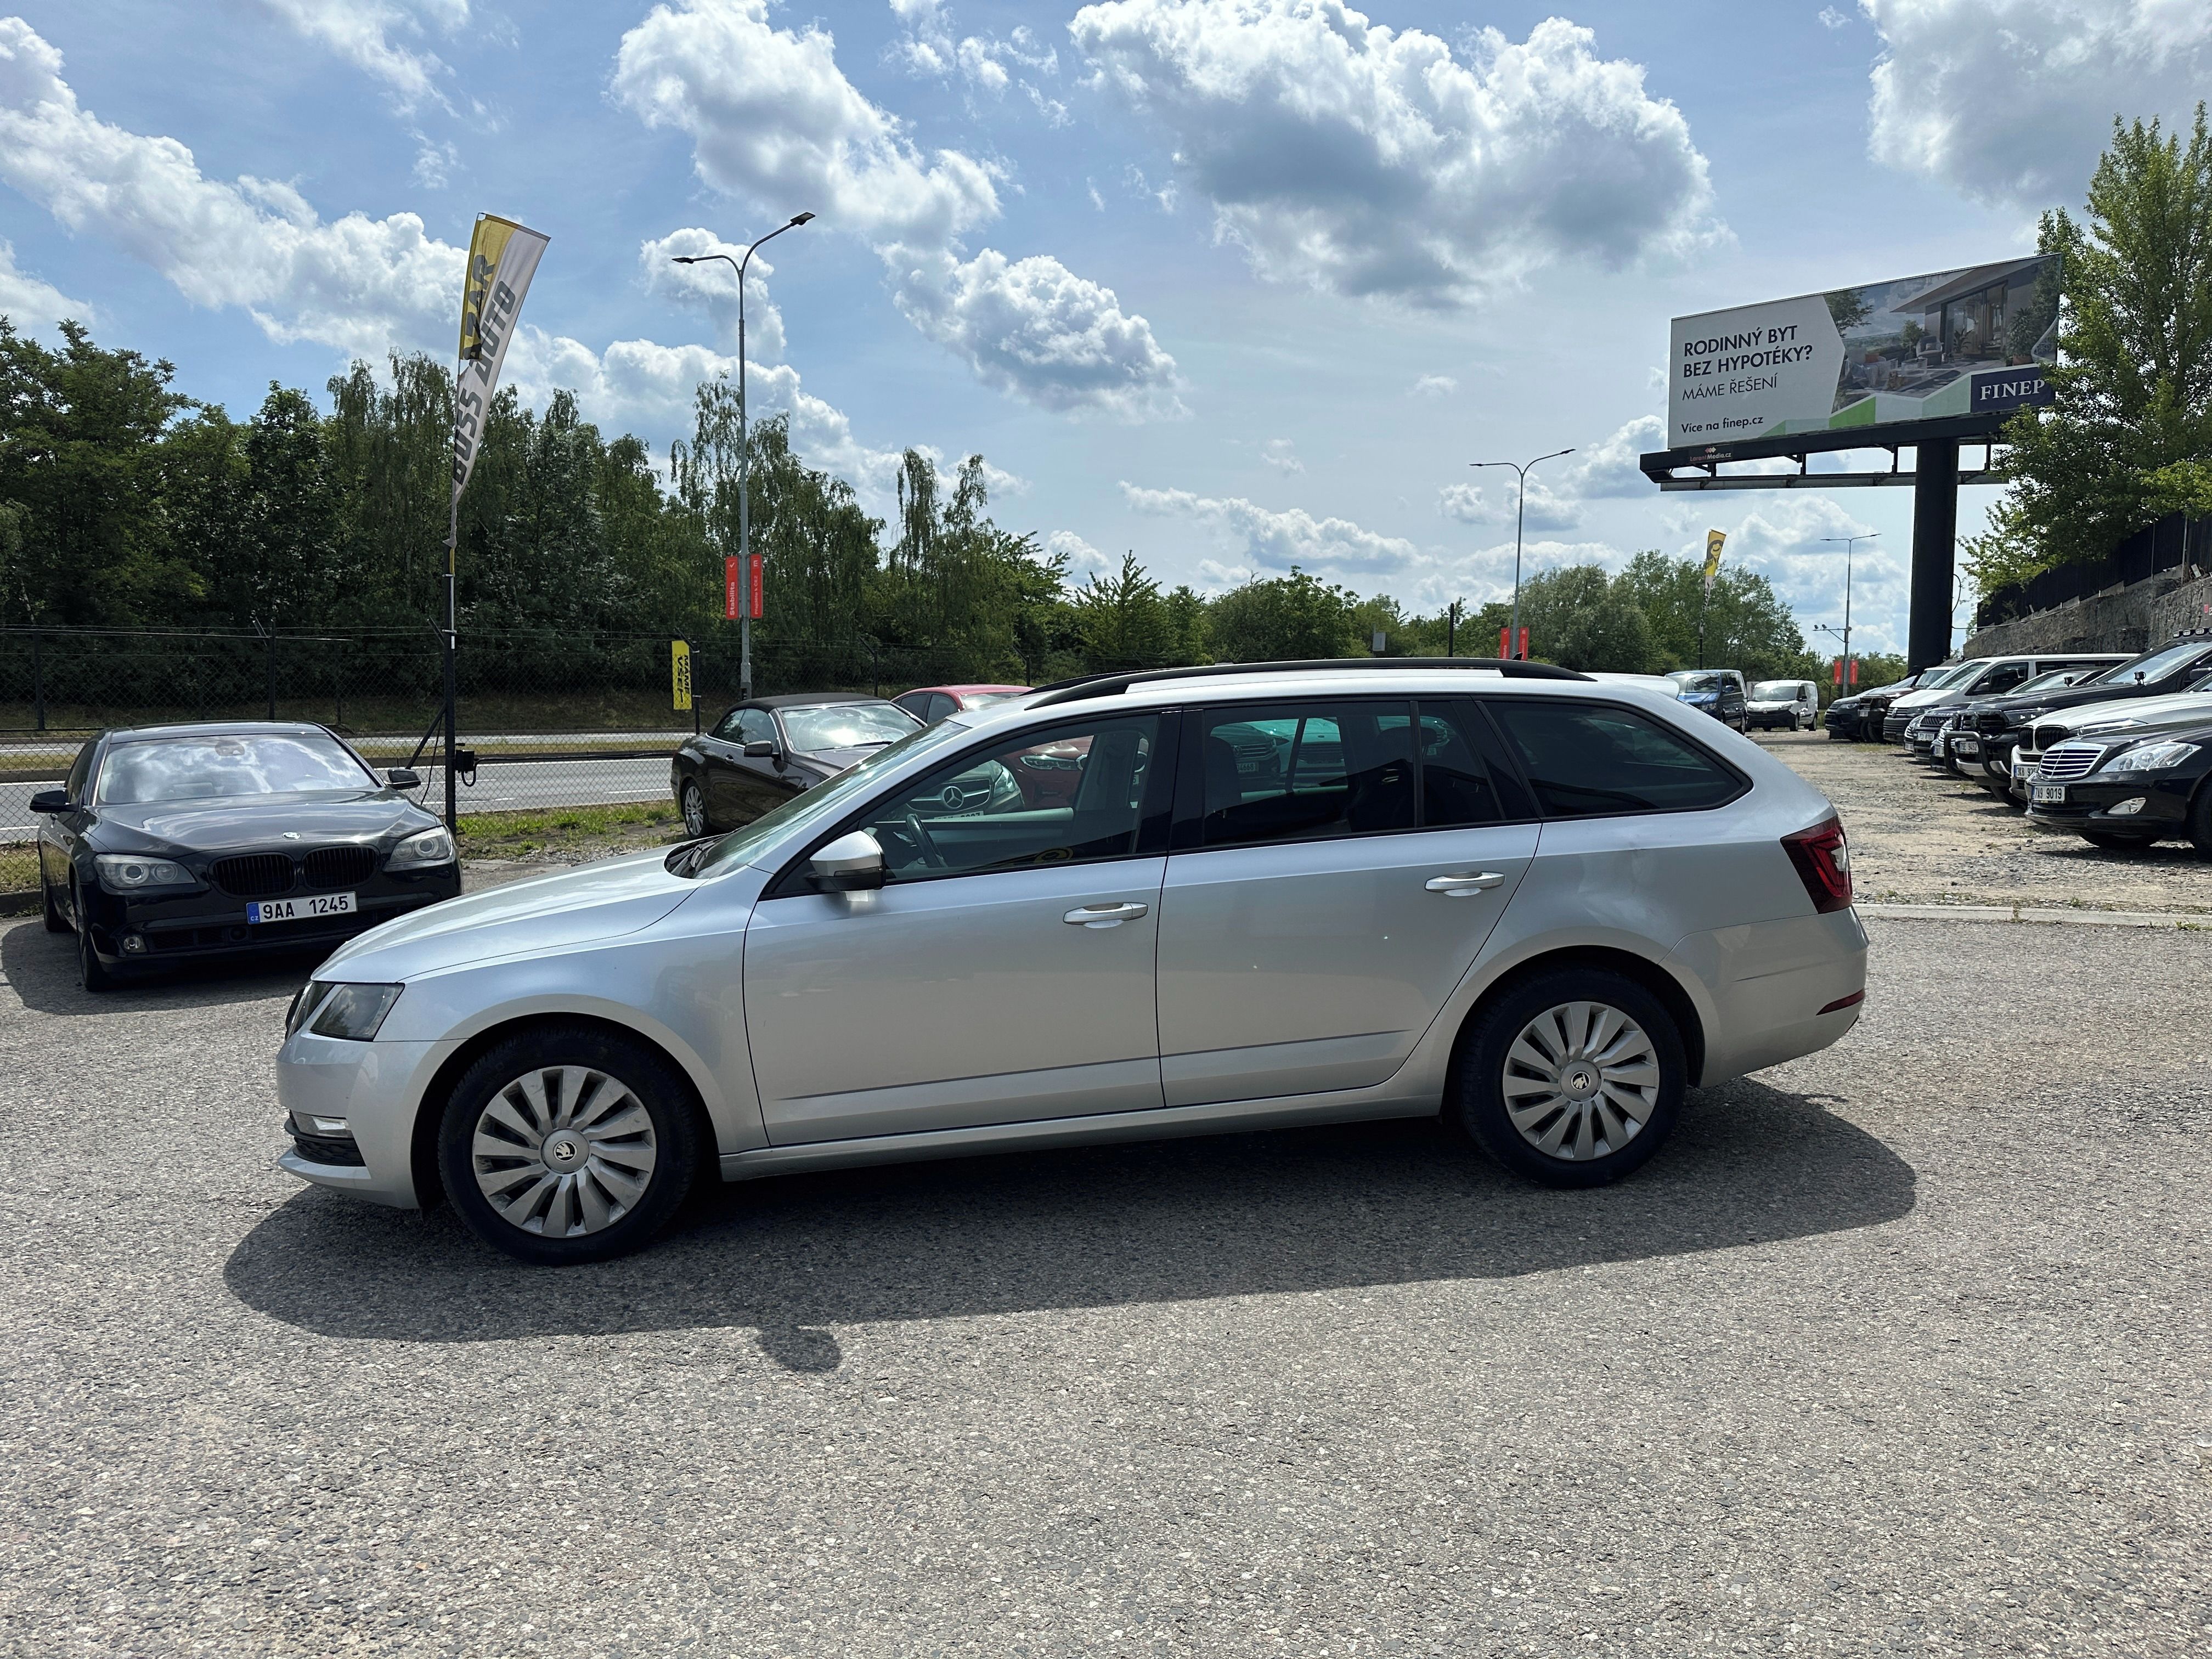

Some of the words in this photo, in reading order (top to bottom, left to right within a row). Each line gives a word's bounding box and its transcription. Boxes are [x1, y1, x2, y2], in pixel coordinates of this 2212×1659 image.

[1684, 327, 1763, 357] RODINNÝ
[1768, 325, 1797, 344] BYT
[1683, 360, 1712, 377] BEZ
[1718, 345, 1813, 373] HYPOTÉKY?
[453, 386, 482, 485] BOSS
[470, 280, 516, 386] AUTO
[1682, 383, 1725, 400] MÁME
[1729, 373, 1778, 394] ŘEŠENÍ
[1979, 378, 2045, 400] FINEP
[1681, 423, 1702, 433] Více
[1706, 422, 1719, 430] na
[1723, 416, 1764, 429] finep.cz
[2046, 787, 2062, 799] 9019
[263, 902, 295, 919] 9AA
[309, 895, 348, 914] 1245
